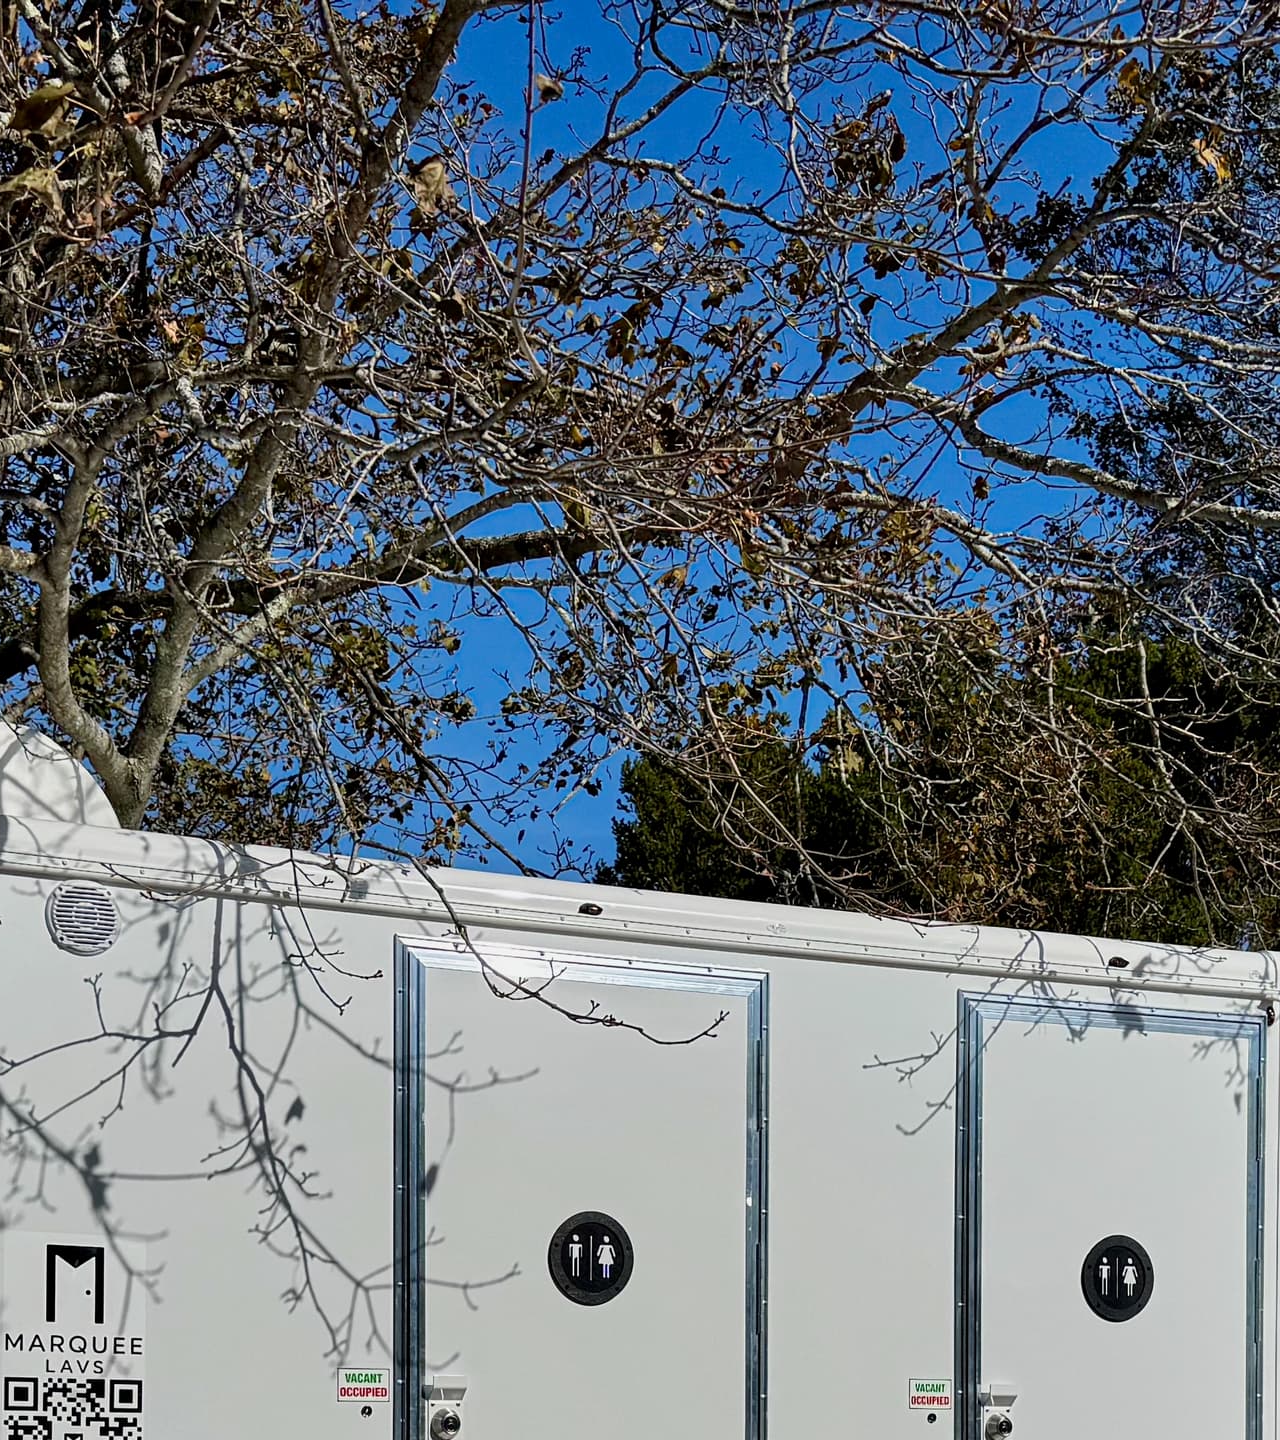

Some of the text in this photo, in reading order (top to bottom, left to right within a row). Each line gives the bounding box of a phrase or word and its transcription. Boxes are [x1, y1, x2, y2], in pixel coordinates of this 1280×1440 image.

[5, 1333, 143, 1355] MARQUEE
[45, 1359, 104, 1374] LAVS
[345, 1373, 383, 1384] VACANT
[340, 1387, 388, 1398] OCCUPIED
[915, 1383, 946, 1393] VACANT
[911, 1396, 950, 1406] OCCUPIED
